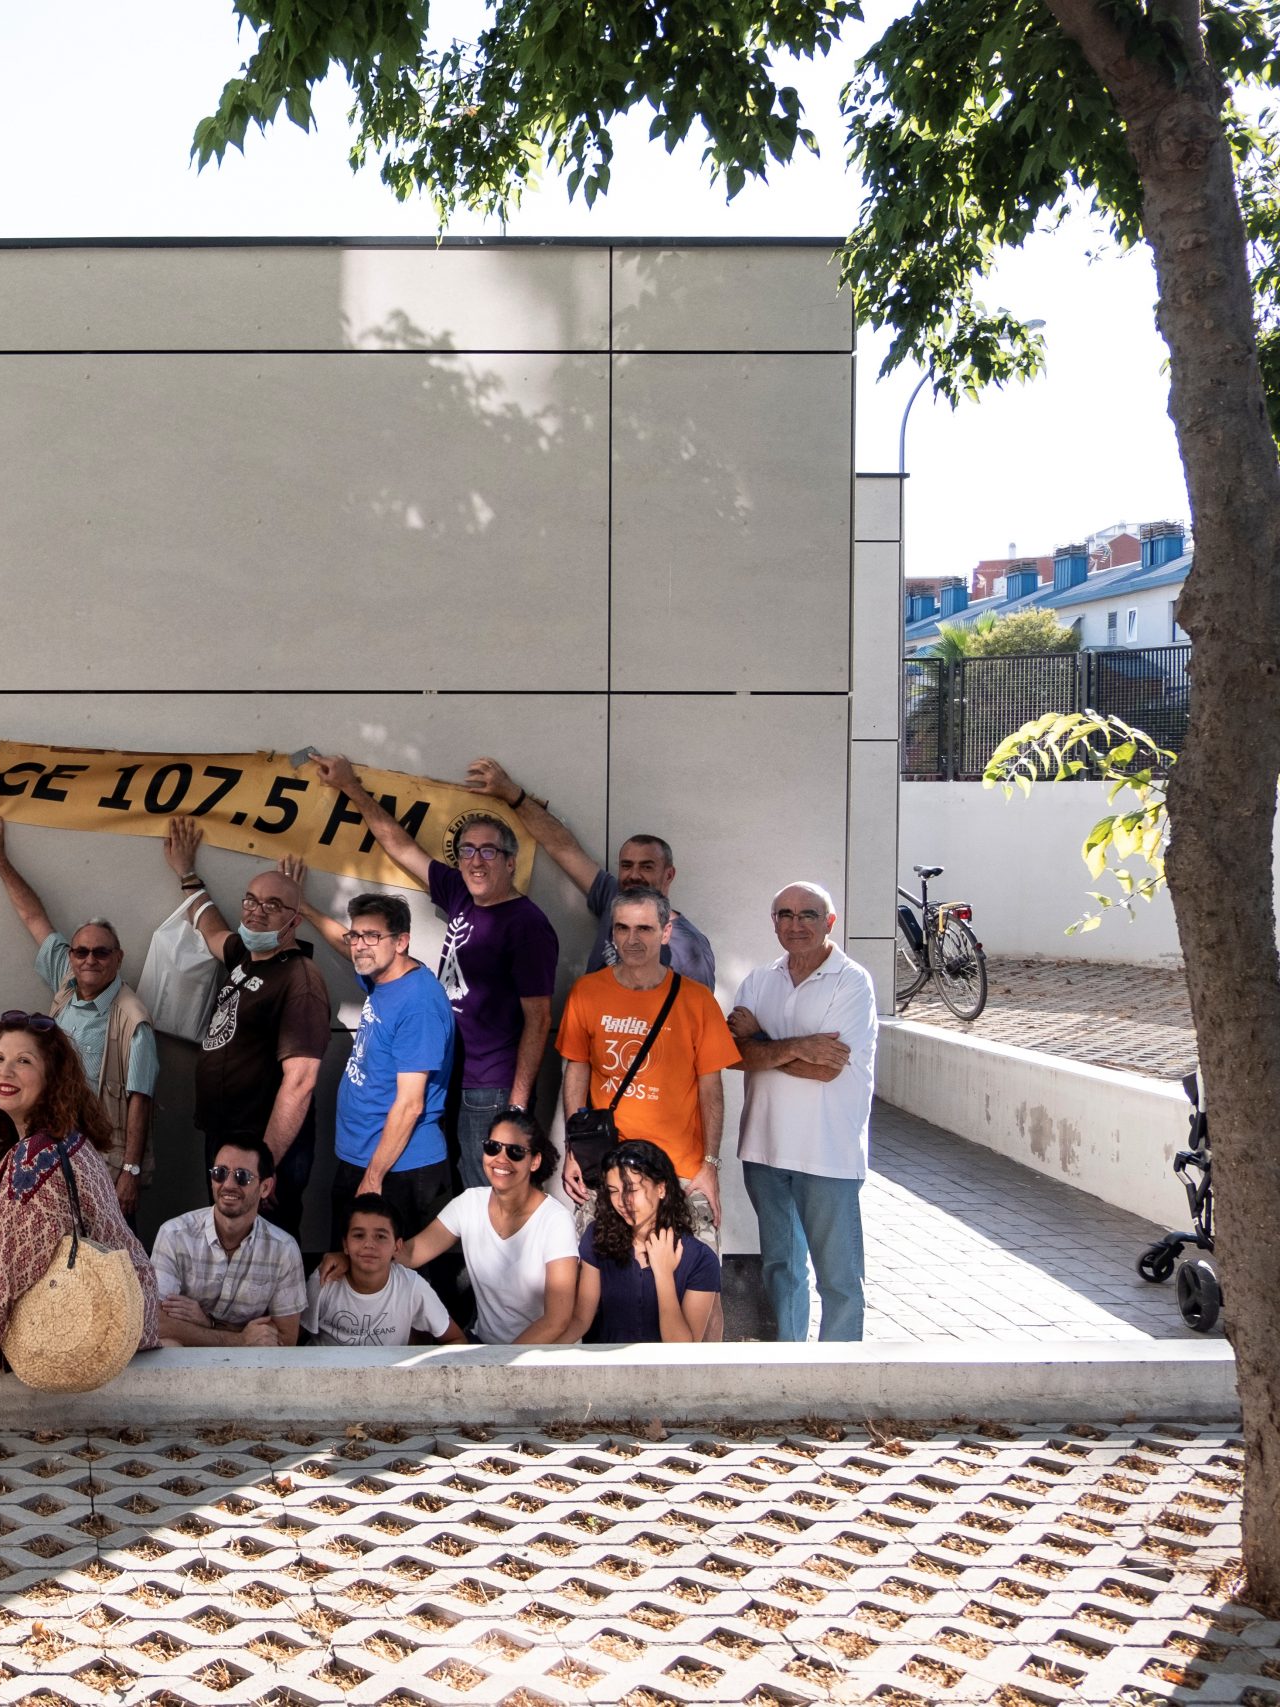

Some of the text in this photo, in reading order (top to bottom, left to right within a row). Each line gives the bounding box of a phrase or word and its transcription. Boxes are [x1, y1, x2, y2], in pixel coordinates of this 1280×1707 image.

[97, 762, 310, 835] 107.5
[601, 1015, 648, 1029] Radio
[331, 1310, 389, 1346] CK
